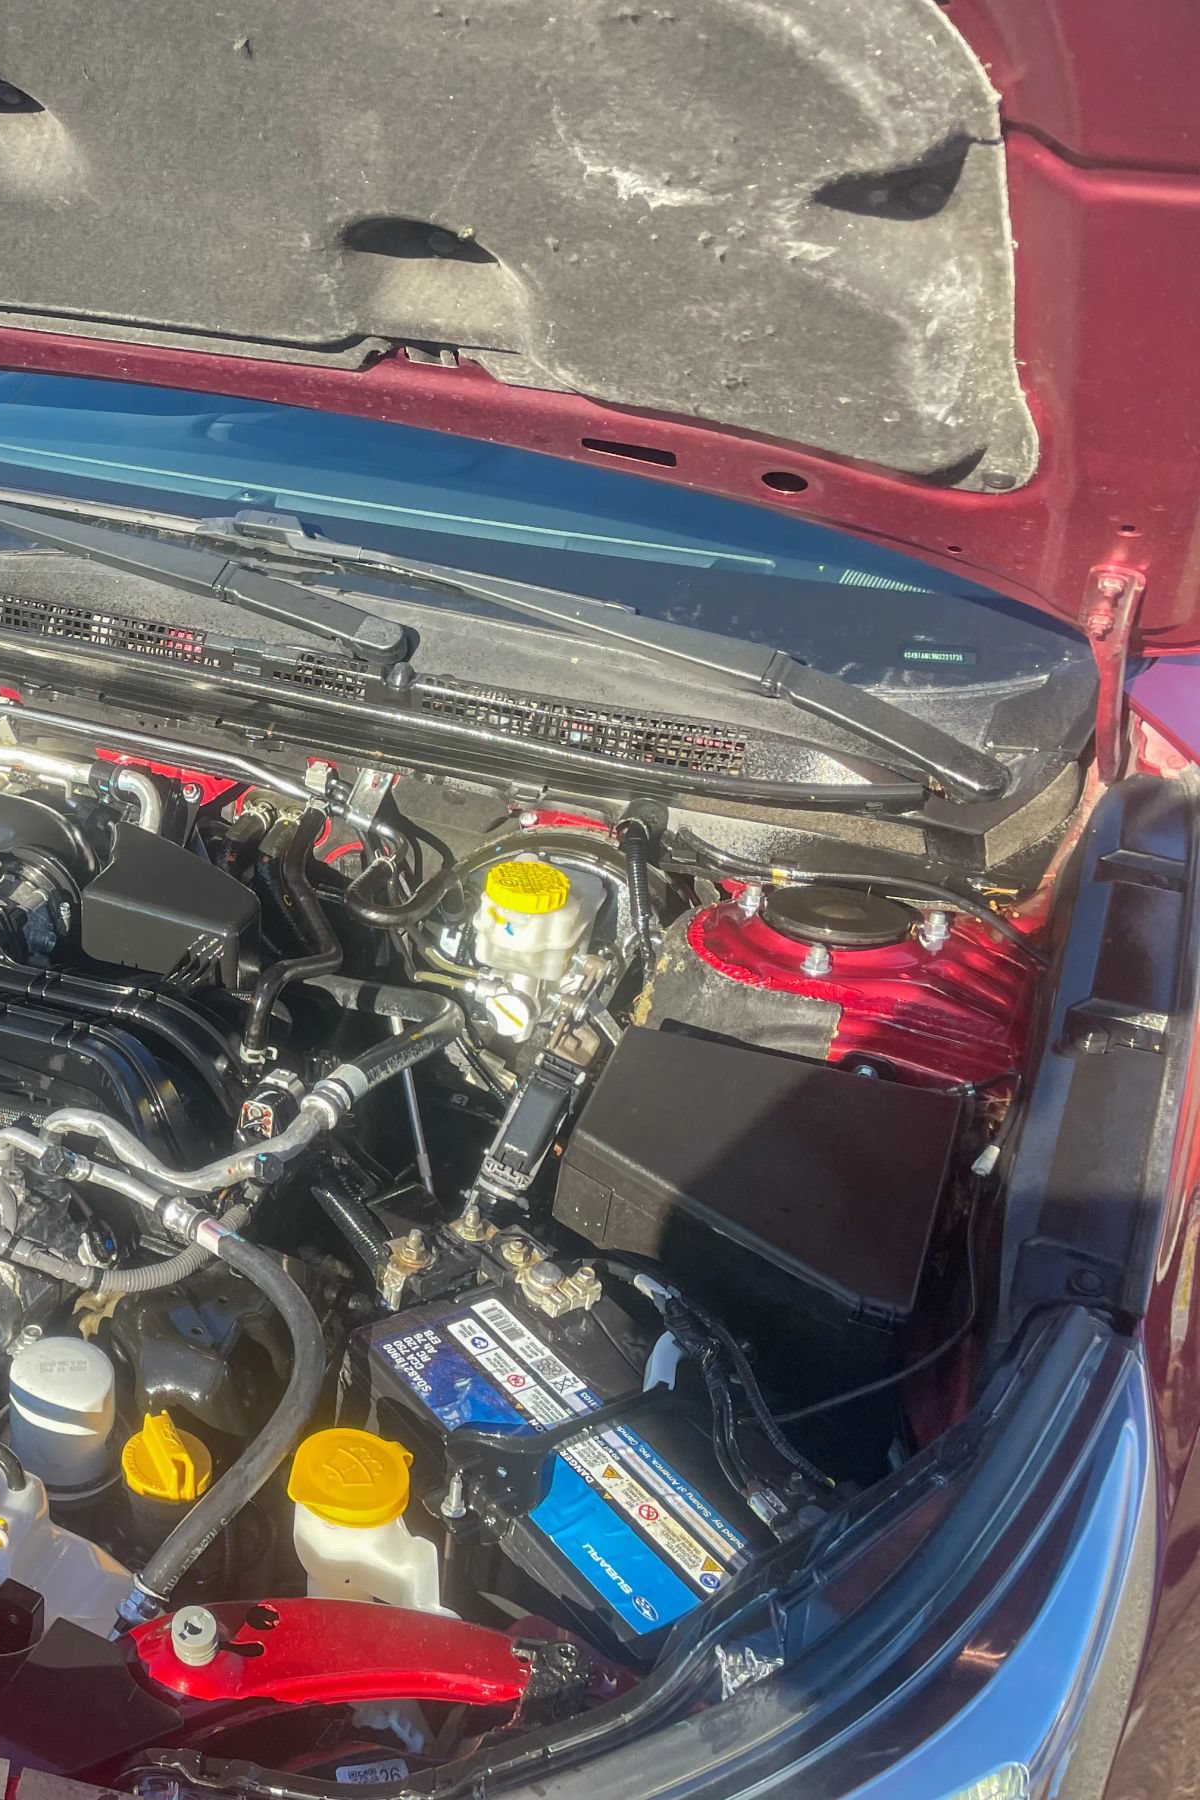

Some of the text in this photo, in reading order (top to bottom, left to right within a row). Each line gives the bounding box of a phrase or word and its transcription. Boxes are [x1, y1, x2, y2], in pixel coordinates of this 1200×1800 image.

[402, 1335, 431, 1362] RC 120
[412, 1332, 438, 1353] Ah 76
[422, 1328, 442, 1344] EFB
[391, 1338, 425, 1370] CCA 750
[558, 1448, 595, 1483] DANGER
[685, 1491, 712, 1517] Subaru
[580, 1542, 634, 1594] SUBARU
